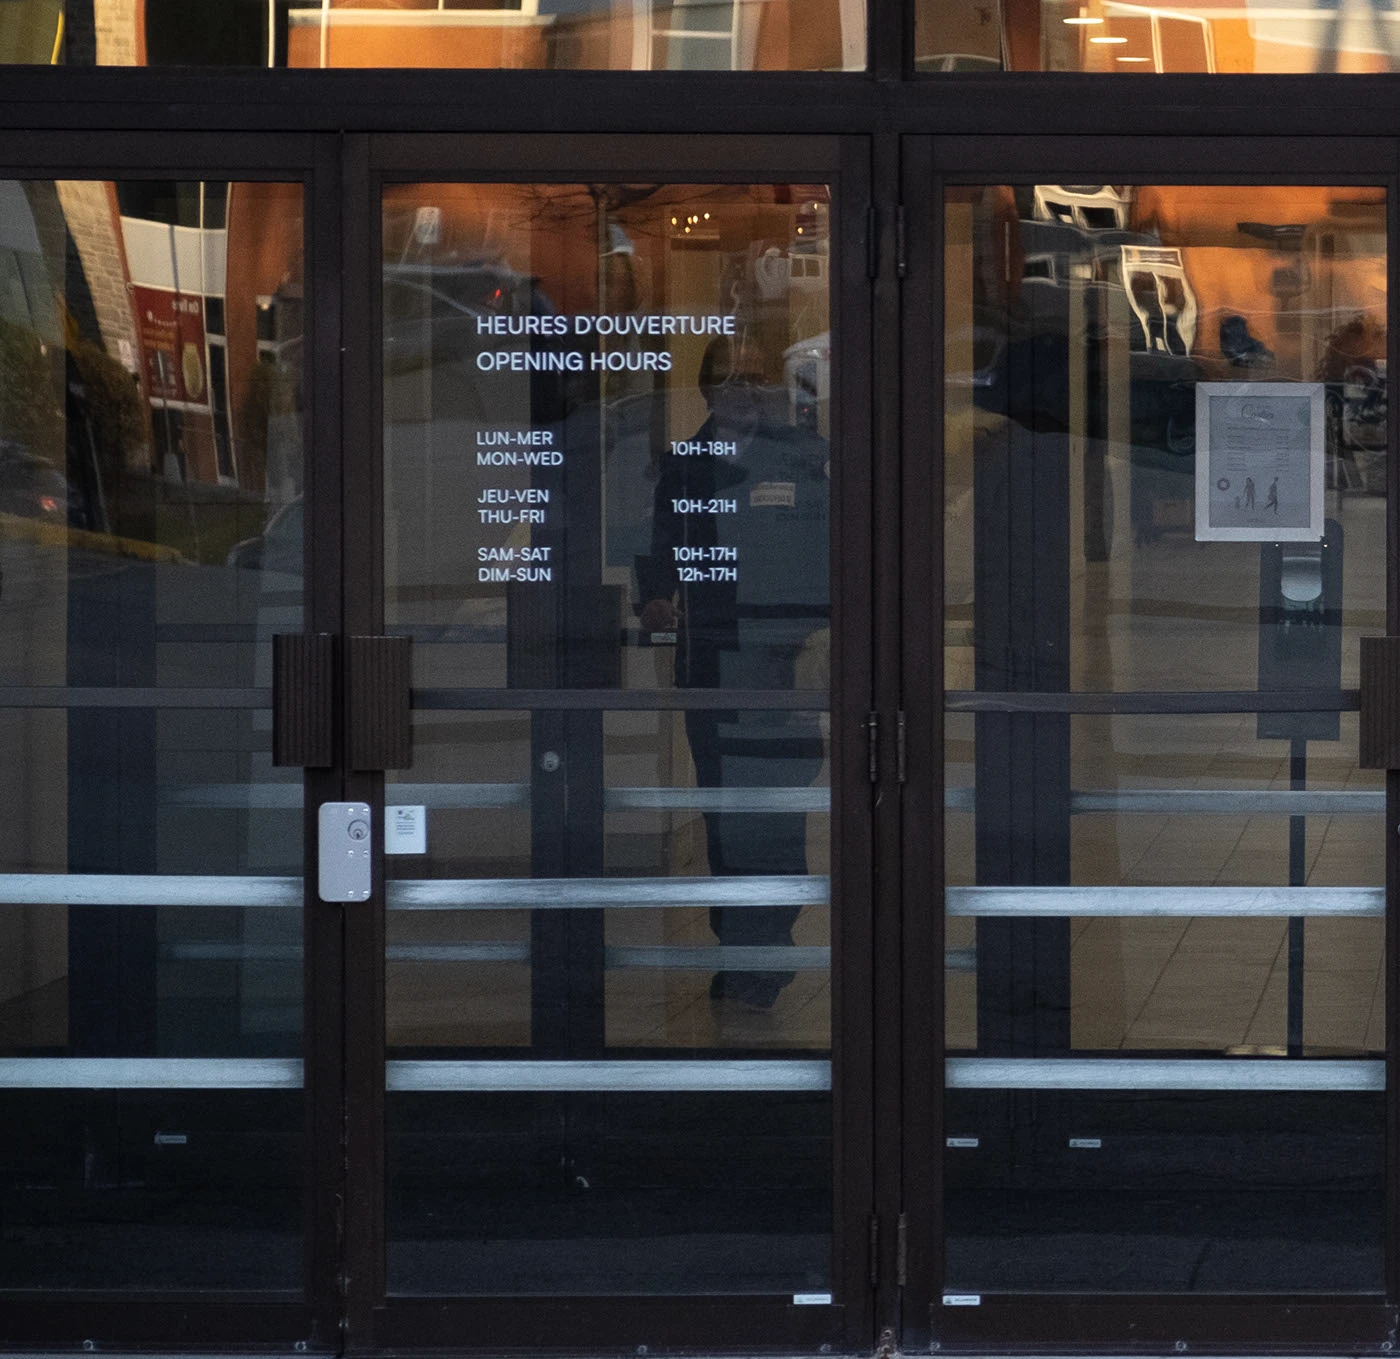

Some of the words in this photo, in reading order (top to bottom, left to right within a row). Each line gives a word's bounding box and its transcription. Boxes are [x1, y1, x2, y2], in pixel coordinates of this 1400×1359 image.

[476, 315, 568, 335] HEURES
[476, 351, 584, 371] OPENING
[590, 351, 672, 371] HOURS
[476, 431, 553, 446] LUN-MER
[670, 441, 737, 456] 10H-18H
[476, 451, 564, 466] MON-WED
[477, 489, 549, 504] JEU-VEN
[671, 499, 737, 514] 10H-21H
[477, 509, 545, 524] THU-FRI
[477, 547, 551, 562] SAM-SAT
[672, 546, 737, 561] 10H-17H
[478, 567, 552, 582] DIM-SUN
[676, 567, 737, 582] 12h-17H
